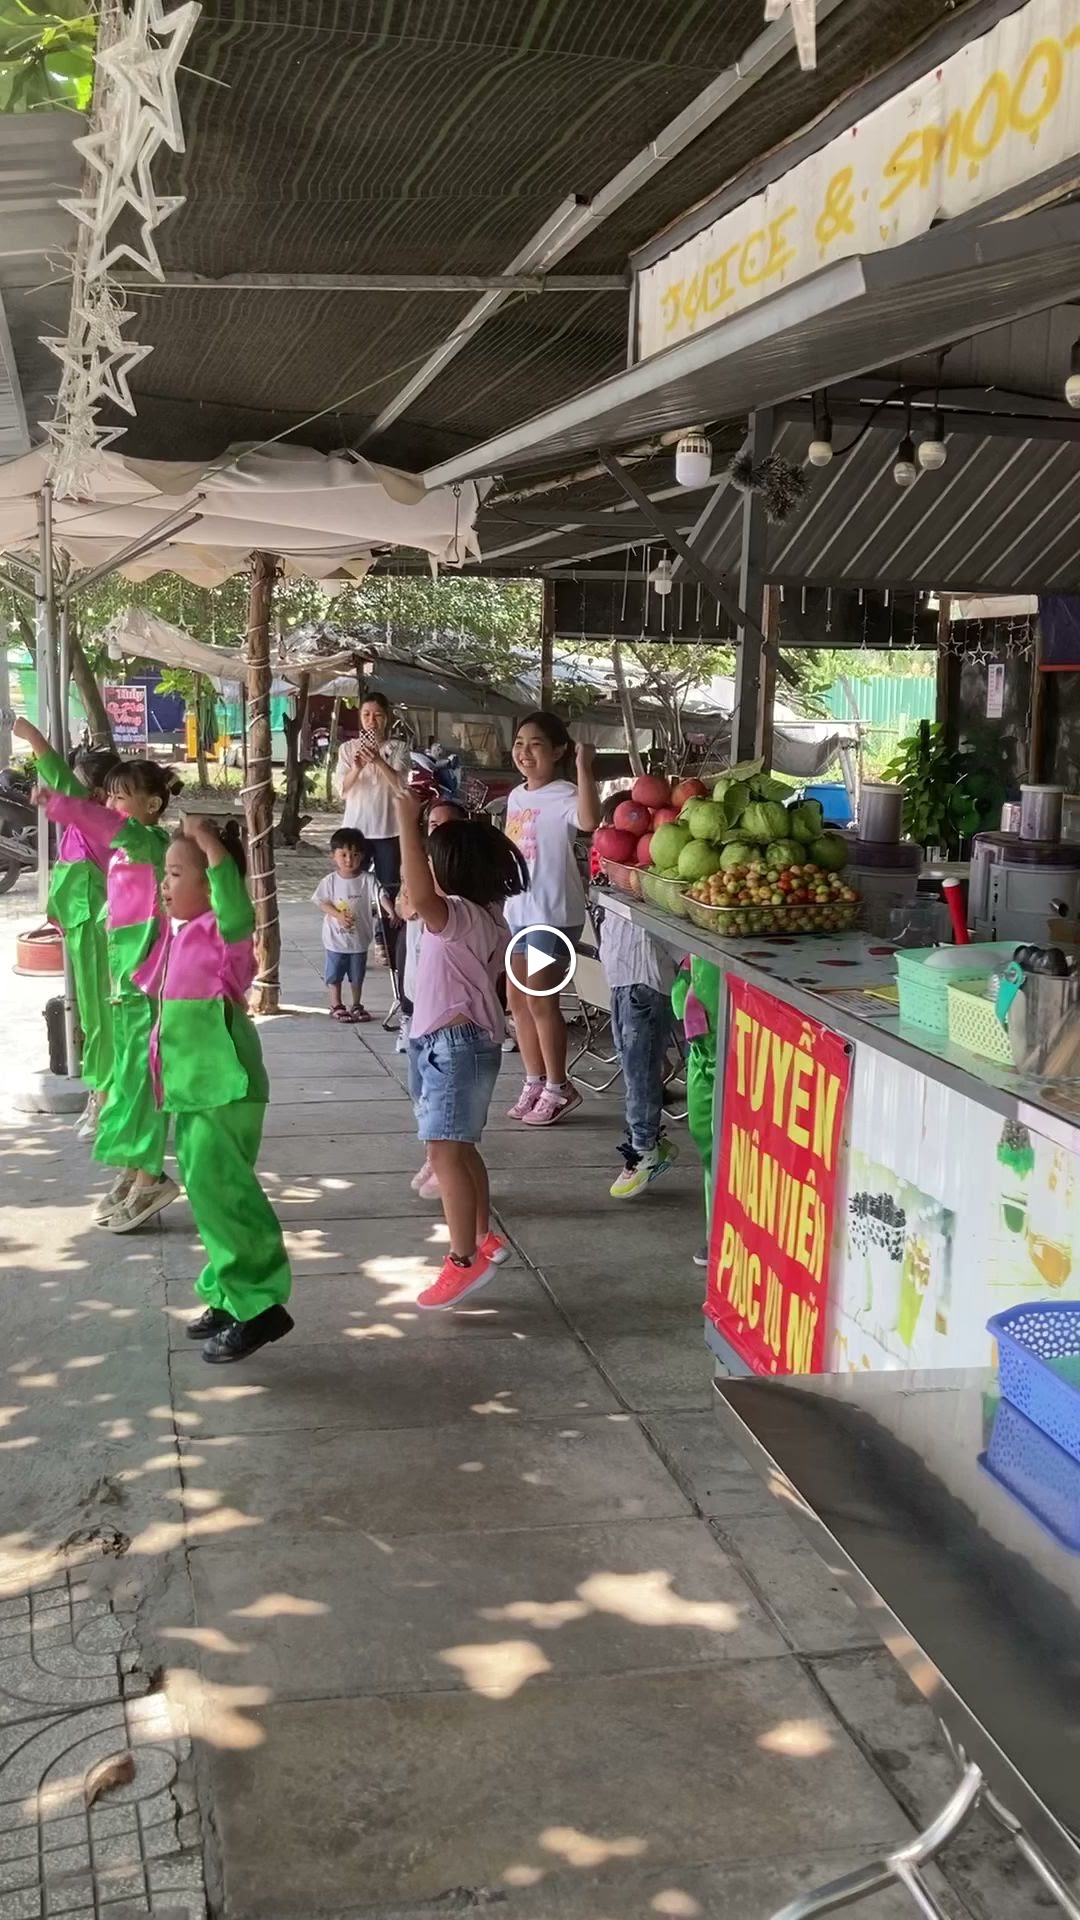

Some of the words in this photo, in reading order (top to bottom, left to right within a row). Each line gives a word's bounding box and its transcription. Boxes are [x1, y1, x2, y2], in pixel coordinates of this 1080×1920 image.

[660, 204, 798, 332] JUICE
[815, 164, 856, 247] &
[879, 26, 1080, 210] SMOO
